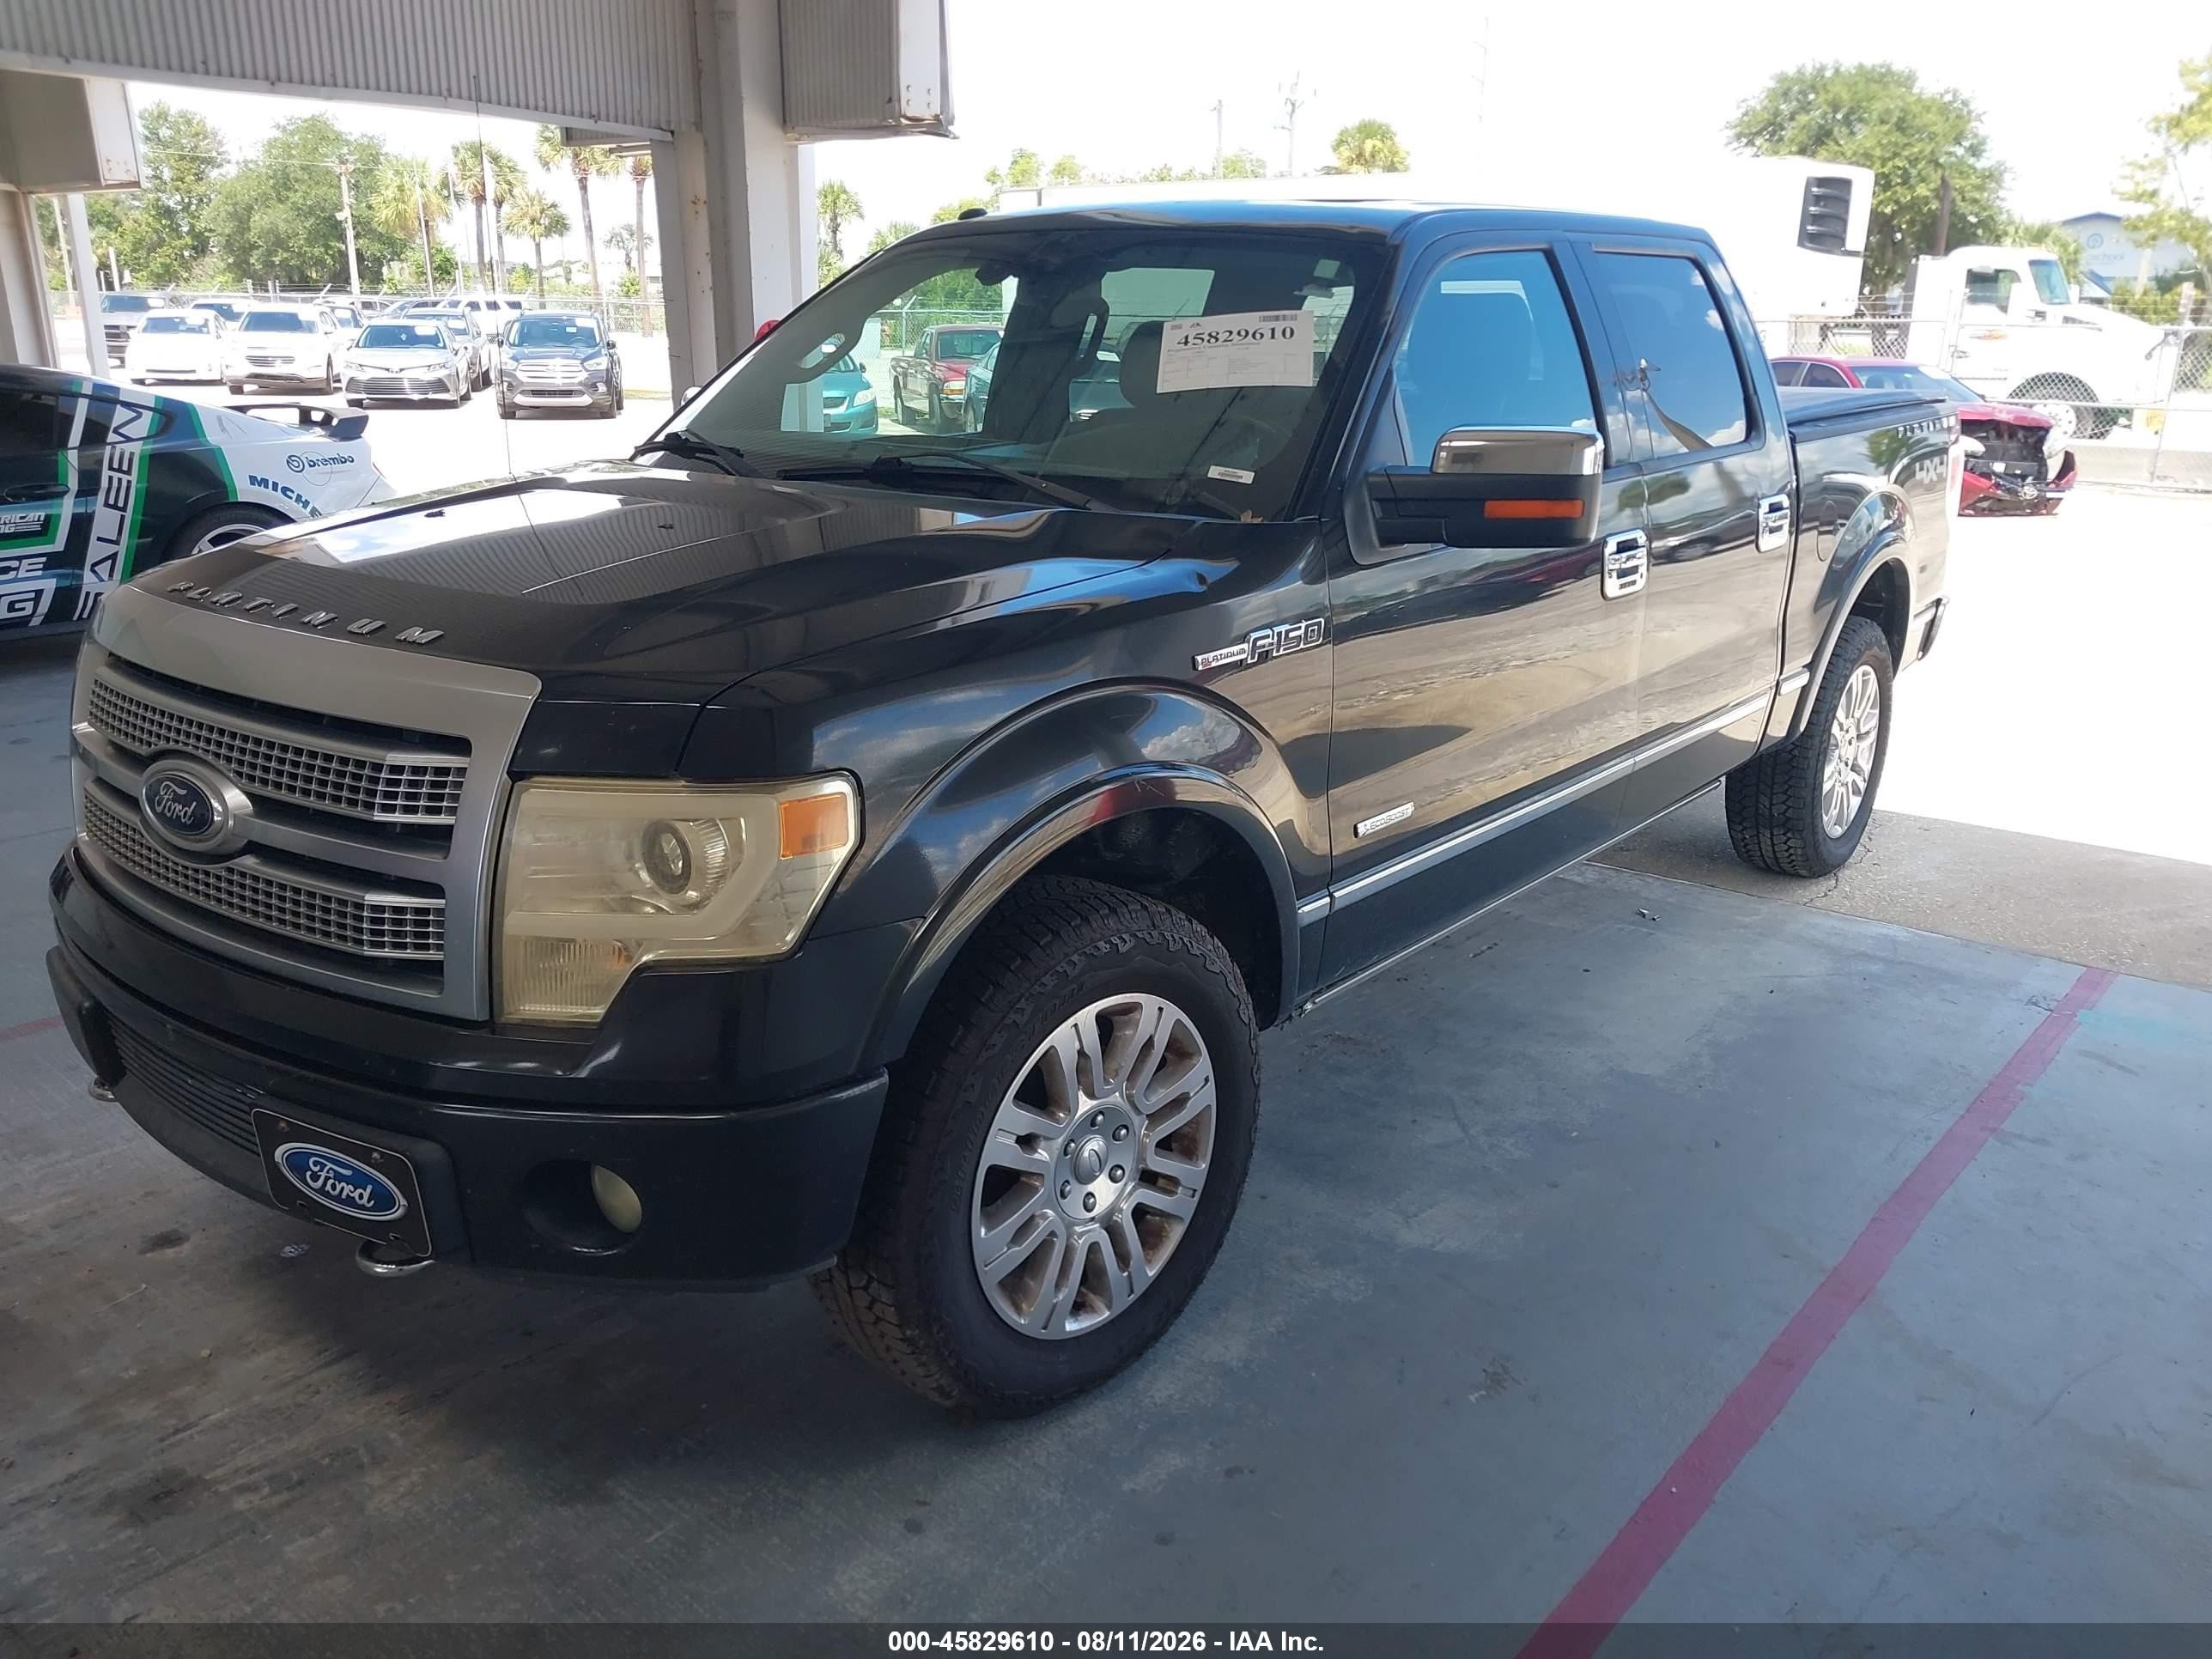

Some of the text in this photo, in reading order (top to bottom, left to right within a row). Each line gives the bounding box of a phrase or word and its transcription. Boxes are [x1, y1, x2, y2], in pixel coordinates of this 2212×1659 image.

[1176, 326, 1295, 347] 45829610
[306, 453, 355, 468] brembo
[248, 475, 323, 518] MICHE
[0, 556, 47, 580] CE
[167, 581, 445, 645] PLATINUM
[1200, 647, 1246, 666] PLATINUM
[155, 781, 198, 825] Ford
[306, 1157, 376, 1207] Ford
